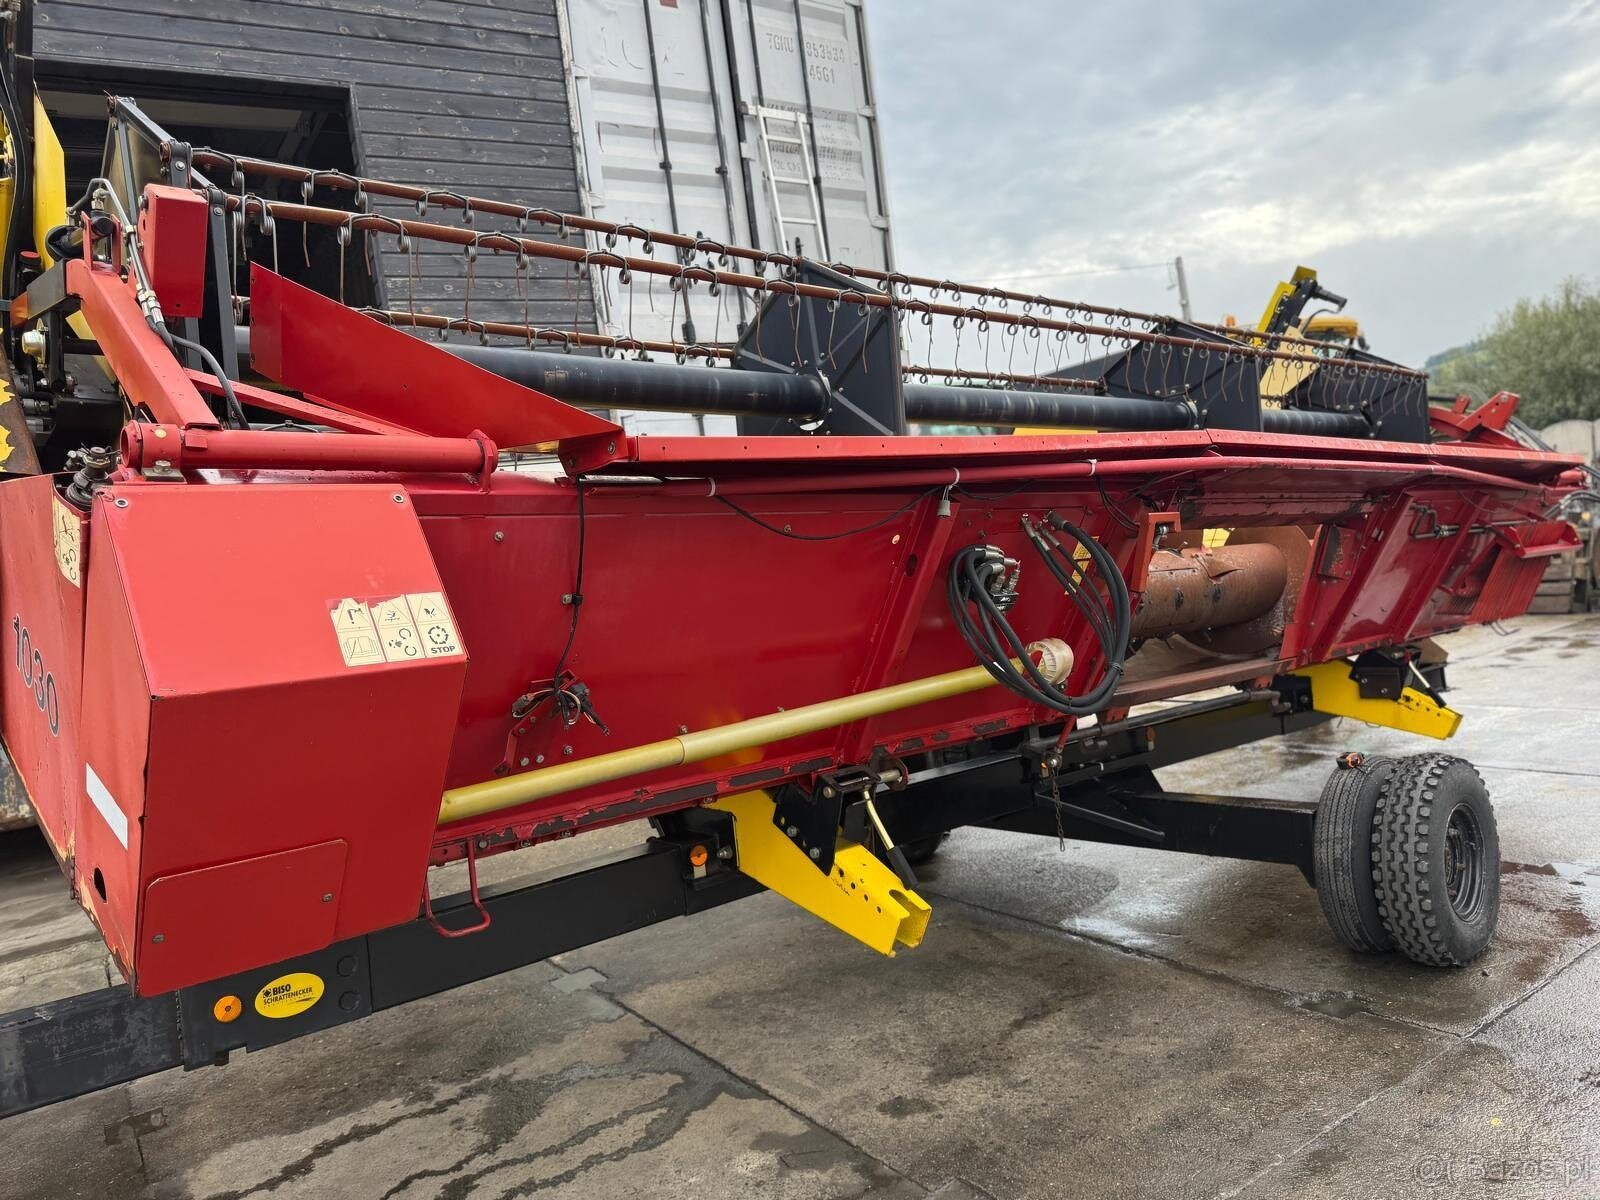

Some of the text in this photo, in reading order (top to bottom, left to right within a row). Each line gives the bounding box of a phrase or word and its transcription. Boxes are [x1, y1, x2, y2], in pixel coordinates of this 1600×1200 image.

[431, 645, 455, 654] STOP
[12, 613, 60, 738] 1030
[263, 987, 312, 1005] SCHRATTENECKER
[272, 984, 291, 995] BISO
